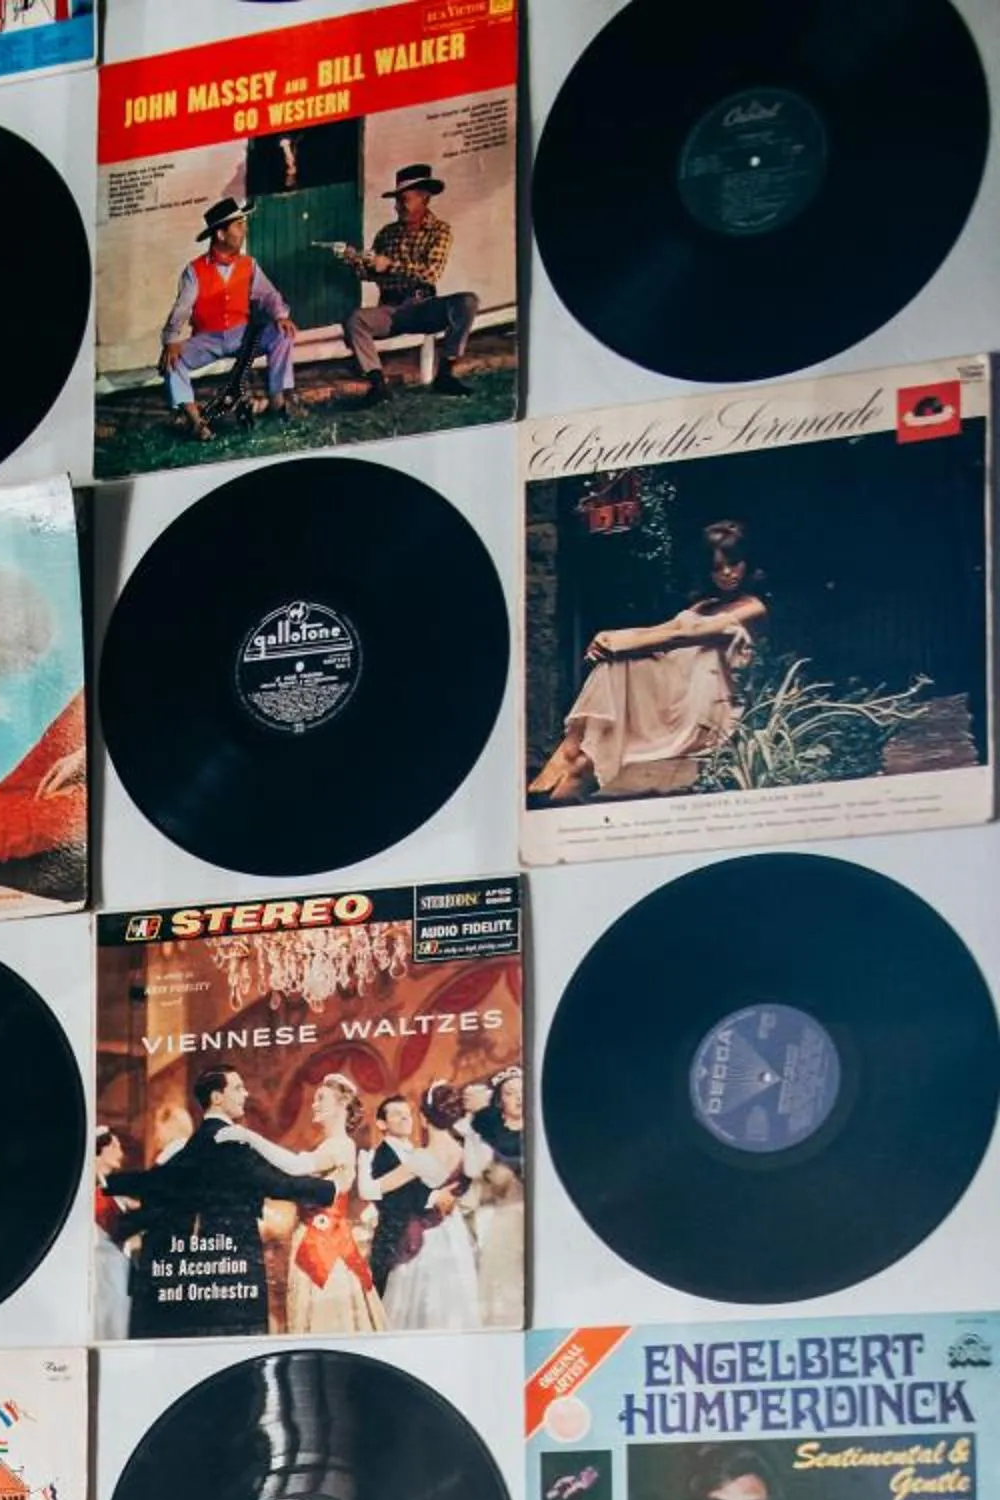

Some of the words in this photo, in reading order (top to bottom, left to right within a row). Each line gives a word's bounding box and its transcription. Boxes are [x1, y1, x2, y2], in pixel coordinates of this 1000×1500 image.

[124, 91, 178, 128] JOHN
[188, 70, 277, 113] MASSEY
[318, 53, 365, 87] BILL
[375, 33, 466, 76] WALKER
[234, 108, 258, 132] GO
[268, 90, 351, 126] WESTERN
[253, 620, 341, 659] gallotone
[171, 894, 373, 939] STEREO
[420, 924, 459, 939] AUDIO
[142, 1024, 318, 1055] VIENNESE
[341, 1010, 504, 1041] WALTZES
[170, 1236, 186, 1253] Jo
[189, 1232, 238, 1254] Basile,
[152, 1259, 173, 1277] his
[178, 1258, 249, 1276] Accordion
[158, 1282, 184, 1301] and
[187, 1281, 259, 1301] Orchestra
[643, 1333, 925, 1386] ENGELBERT
[618, 1381, 976, 1437] HUMPERDINCK
[793, 1440, 945, 1471] Sentimental
[947, 1438, 970, 1465] &
